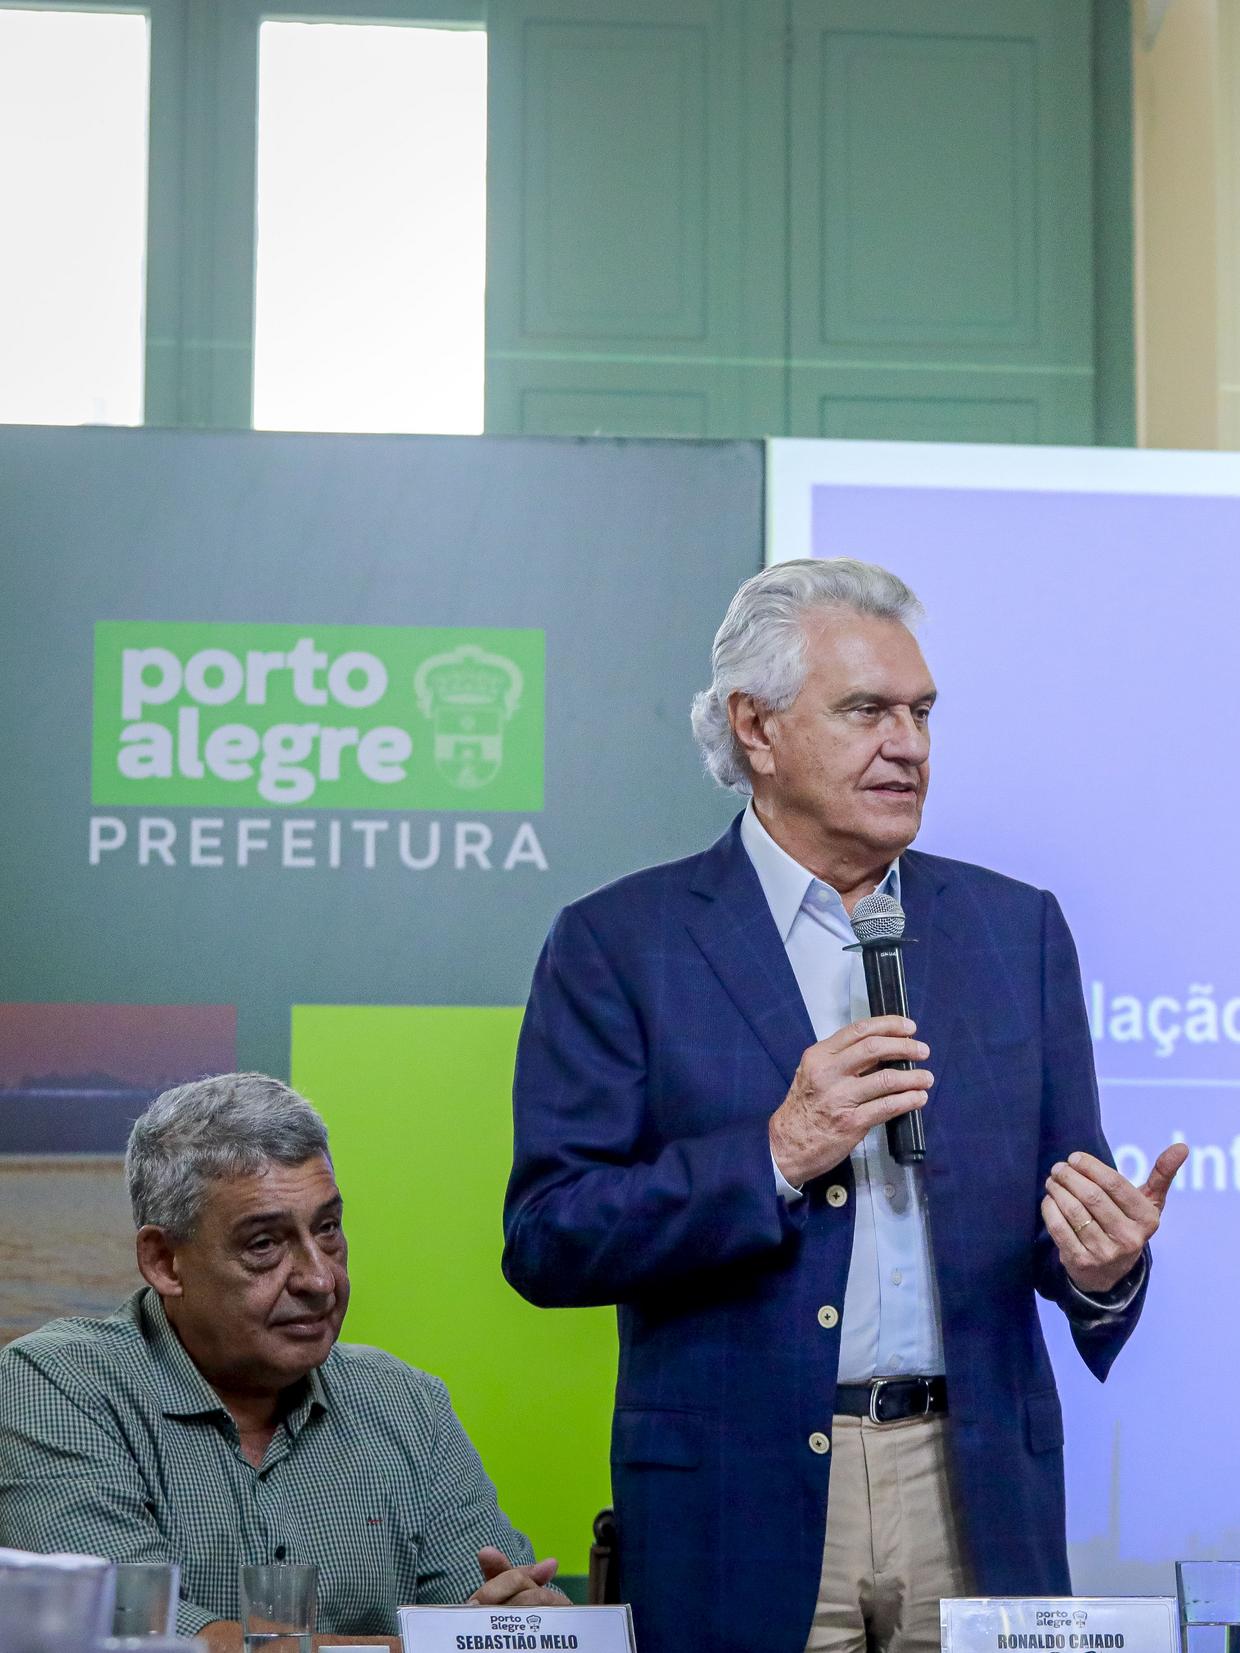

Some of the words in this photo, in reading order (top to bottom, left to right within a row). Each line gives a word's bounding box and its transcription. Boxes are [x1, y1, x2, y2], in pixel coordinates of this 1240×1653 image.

[121, 637, 388, 720] porto
[117, 706, 413, 804] alegre
[88, 816, 549, 871] PREFEITURA
[490, 1615, 521, 1624] porto
[1036, 1610, 1068, 1620] porto
[491, 1622, 526, 1632] alegre
[1036, 1618, 1072, 1628] alegre
[456, 1633, 536, 1650] SEBASTIÃO
[541, 1635, 578, 1649] MELO
[998, 1634, 1065, 1649] RONALDO
[1069, 1634, 1124, 1649] CAIADO
